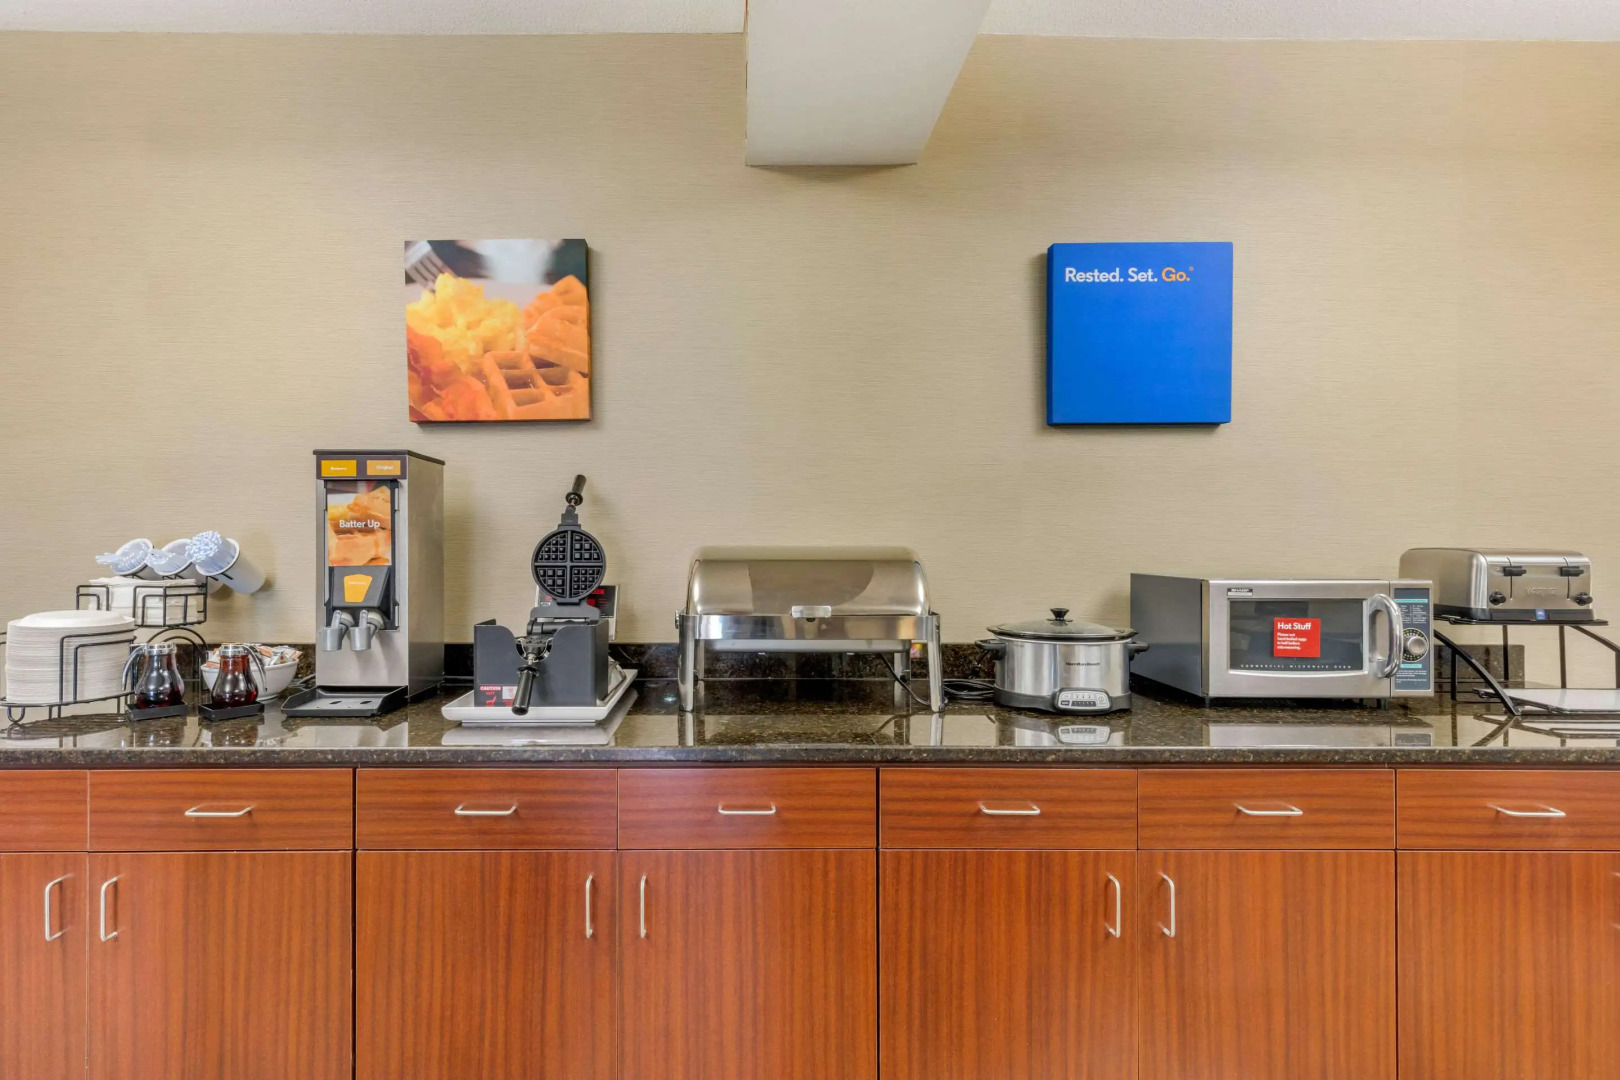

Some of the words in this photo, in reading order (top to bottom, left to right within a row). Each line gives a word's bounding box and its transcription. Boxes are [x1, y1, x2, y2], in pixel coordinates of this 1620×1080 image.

[1065, 267, 1124, 283] Rested.
[1127, 267, 1158, 283] Set.
[338, 519, 366, 528] Batter
[368, 519, 380, 530] Up
[1293, 622, 1312, 630] Stuff
